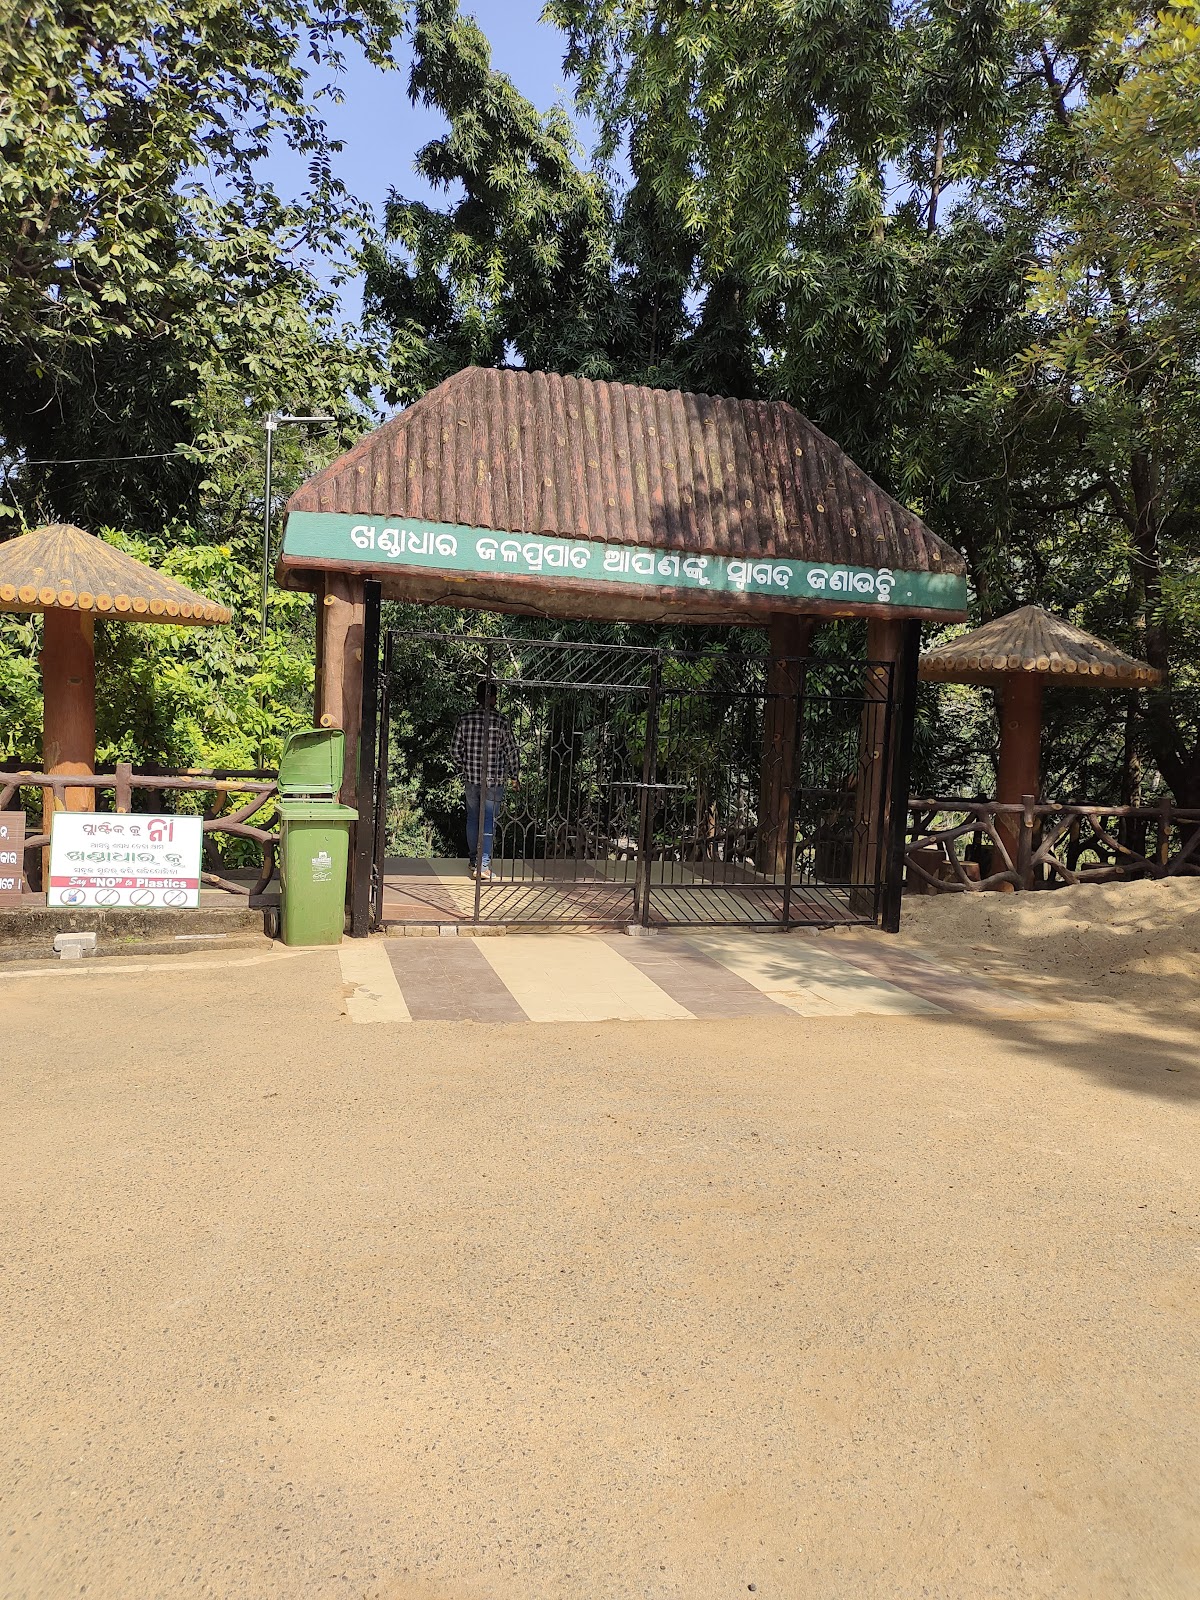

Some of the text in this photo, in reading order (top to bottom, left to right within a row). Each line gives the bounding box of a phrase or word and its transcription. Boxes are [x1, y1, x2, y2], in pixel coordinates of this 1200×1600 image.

[350, 525, 458, 558] ଖଣ୍ଡାଧାର
[475, 538, 591, 571] ଜଳପ୍ରପାତ
[603, 550, 711, 586] ଆପଣଙ୍କୁ
[69, 876, 87, 887] Say
[136, 878, 187, 888] Plastics
